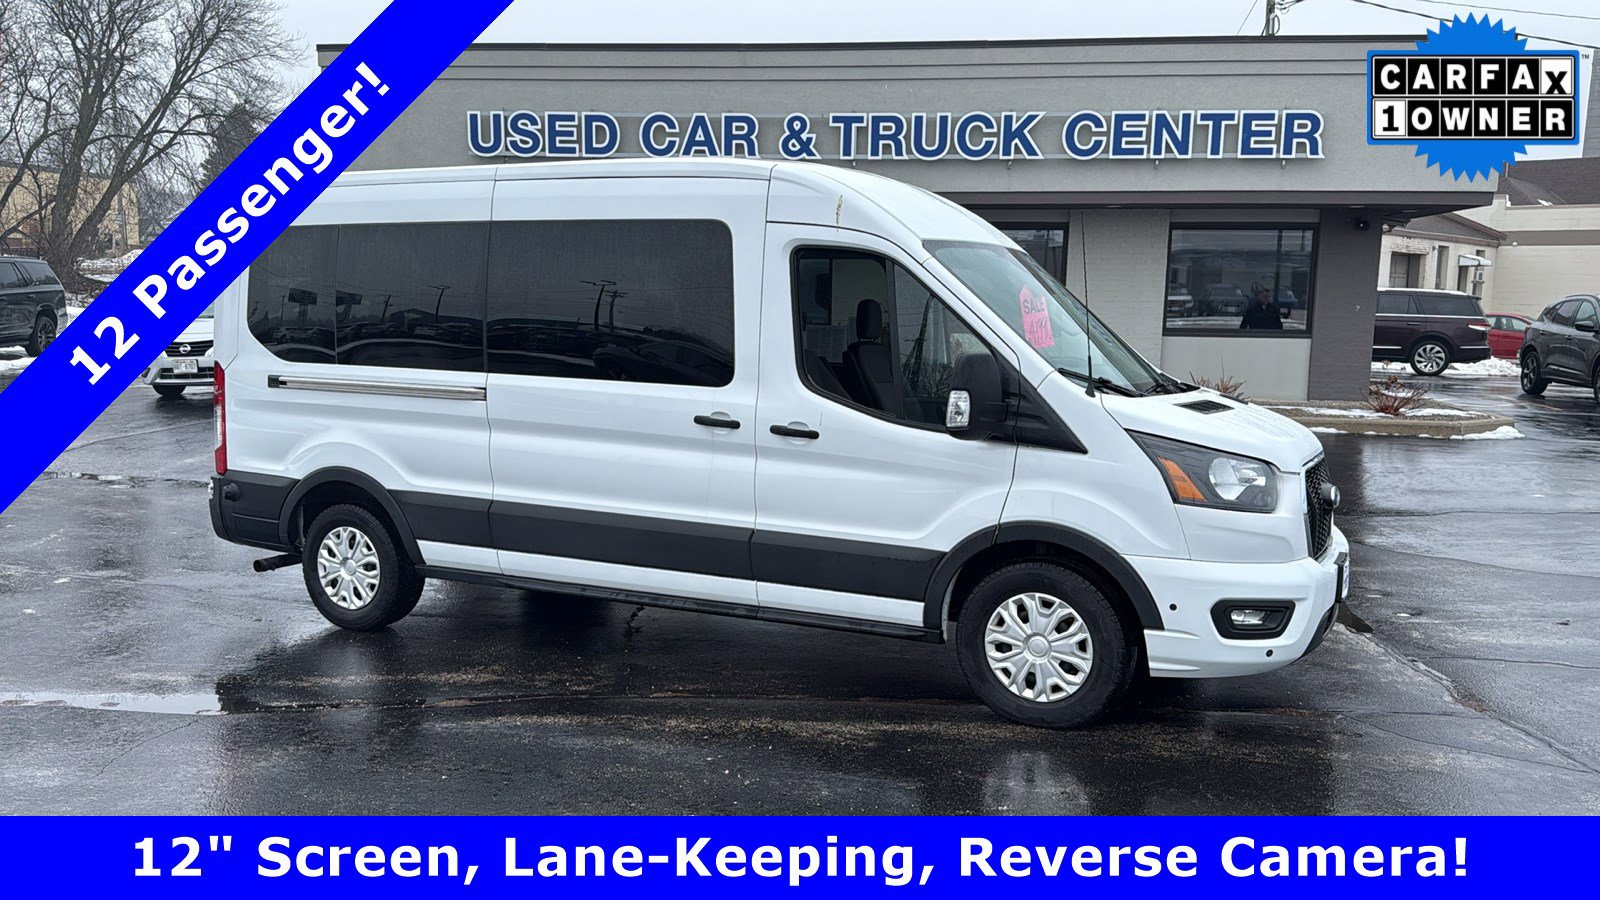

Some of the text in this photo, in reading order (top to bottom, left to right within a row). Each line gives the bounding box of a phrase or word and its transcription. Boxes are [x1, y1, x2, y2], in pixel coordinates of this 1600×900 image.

[467, 110, 1325, 160] USED CAR & TRUCK CENTER
[1022, 297, 1046, 315] SALE
